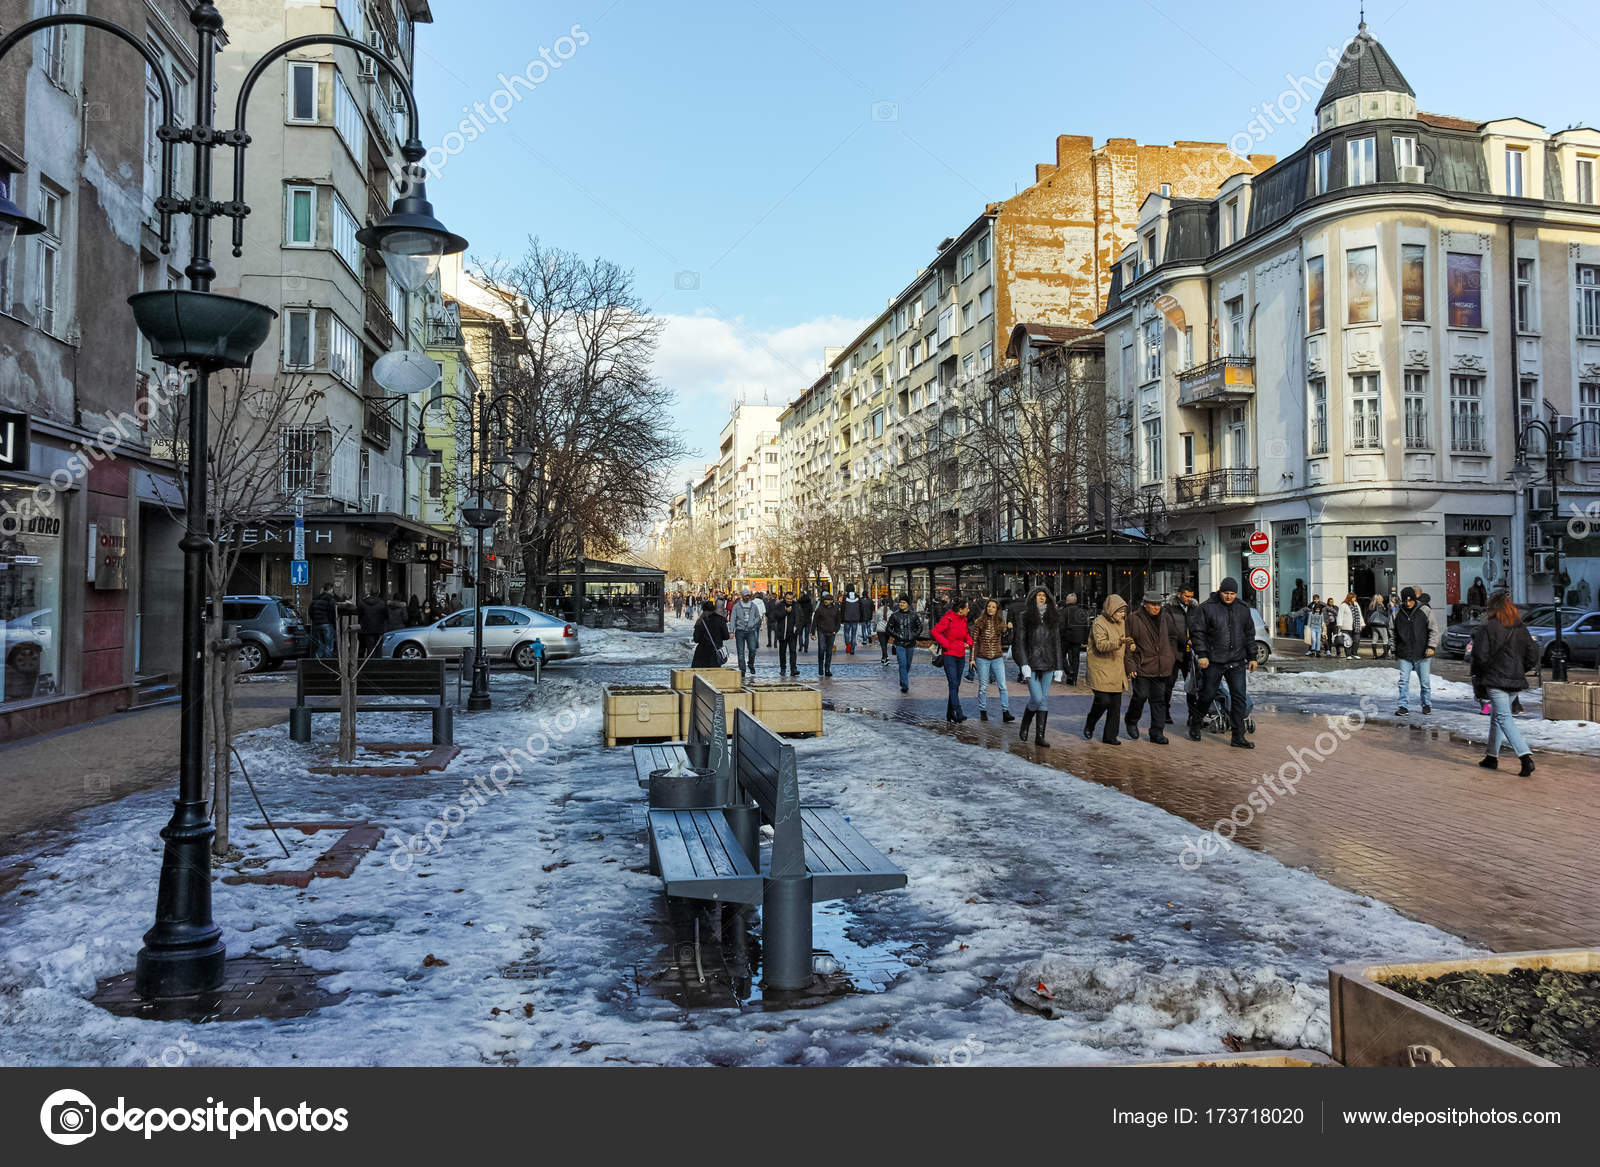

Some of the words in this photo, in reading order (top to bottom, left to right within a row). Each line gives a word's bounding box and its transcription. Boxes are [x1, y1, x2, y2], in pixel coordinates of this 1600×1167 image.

[1281, 523, 1299, 536] НИКО
[1463, 519, 1492, 532] НИКО
[1230, 527, 1246, 539] НИКО
[1353, 540, 1389, 553] НИКО
